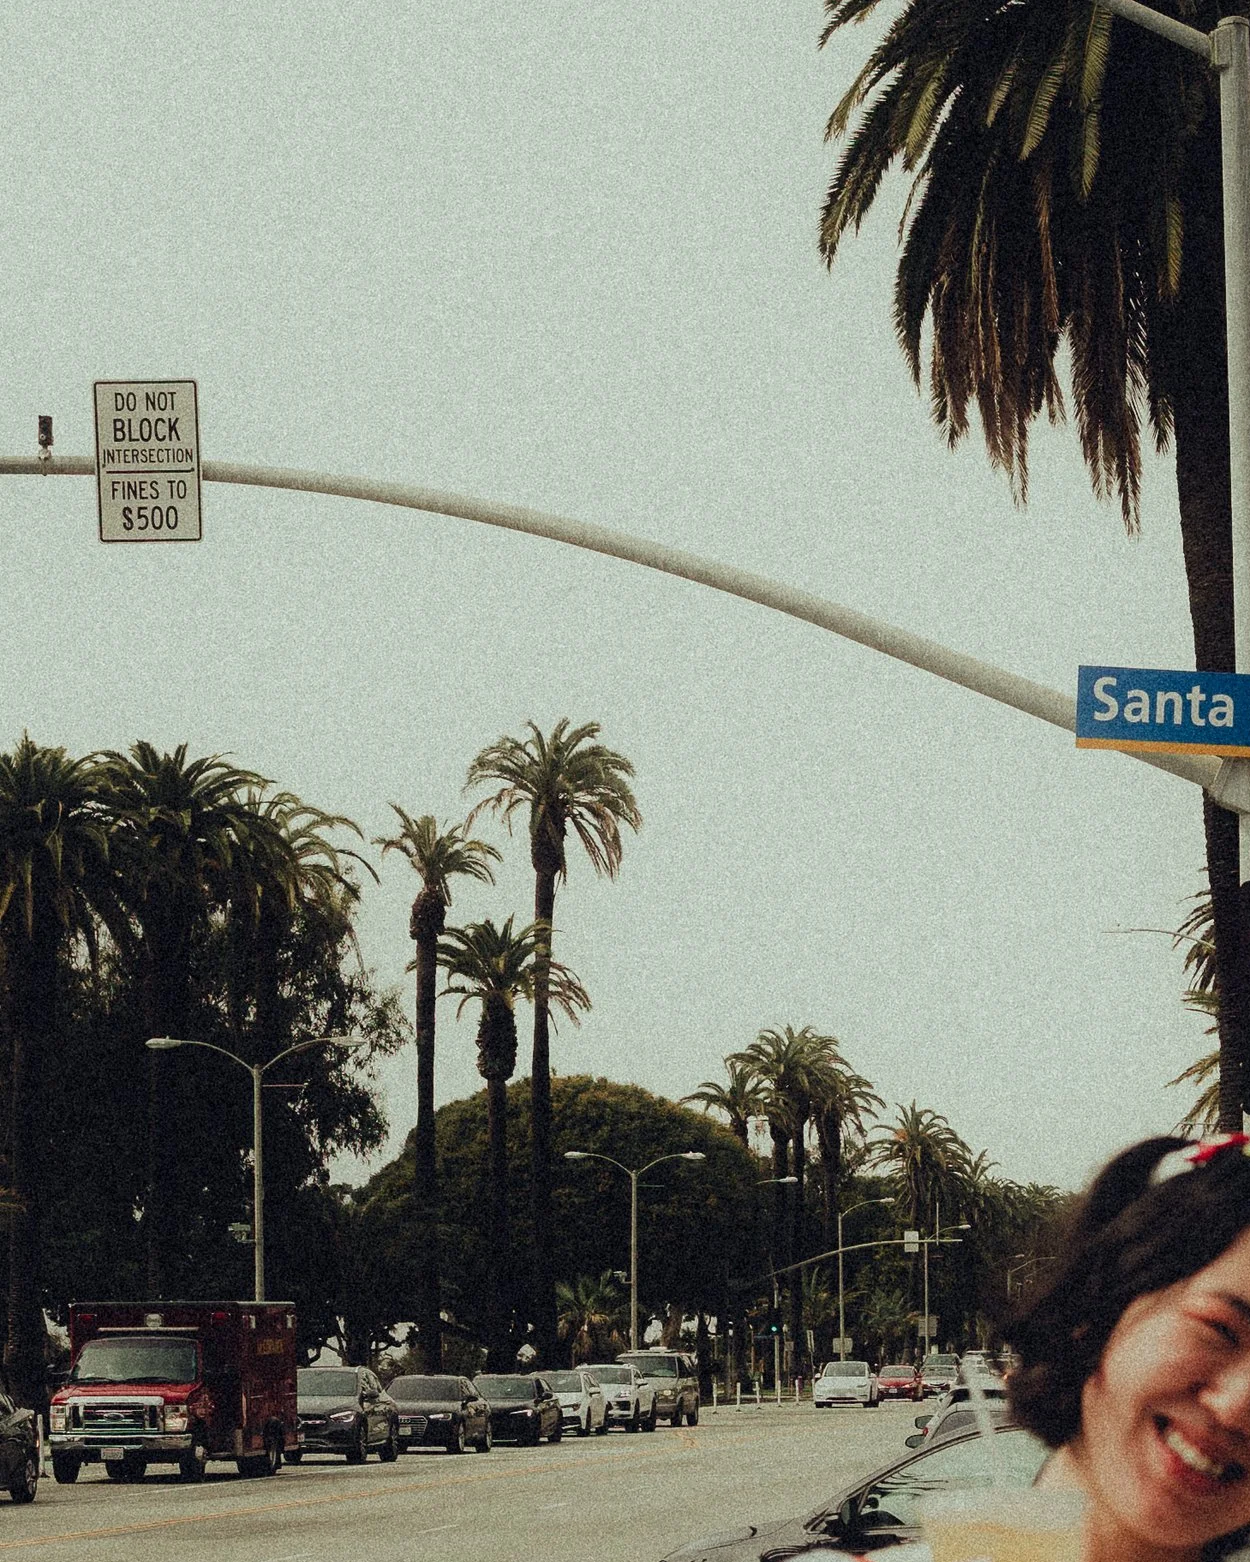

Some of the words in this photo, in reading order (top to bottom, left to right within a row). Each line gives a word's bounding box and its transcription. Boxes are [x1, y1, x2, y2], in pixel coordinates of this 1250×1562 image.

[114, 392, 137, 412] DO
[145, 391, 177, 412] NOT
[112, 417, 181, 443] BLOCK
[103, 448, 194, 465] INTERSECTION
[111, 480, 160, 501] FINES
[167, 479, 188, 500] TO
[121, 505, 179, 531] $500
[1092, 676, 1235, 728] Santa
